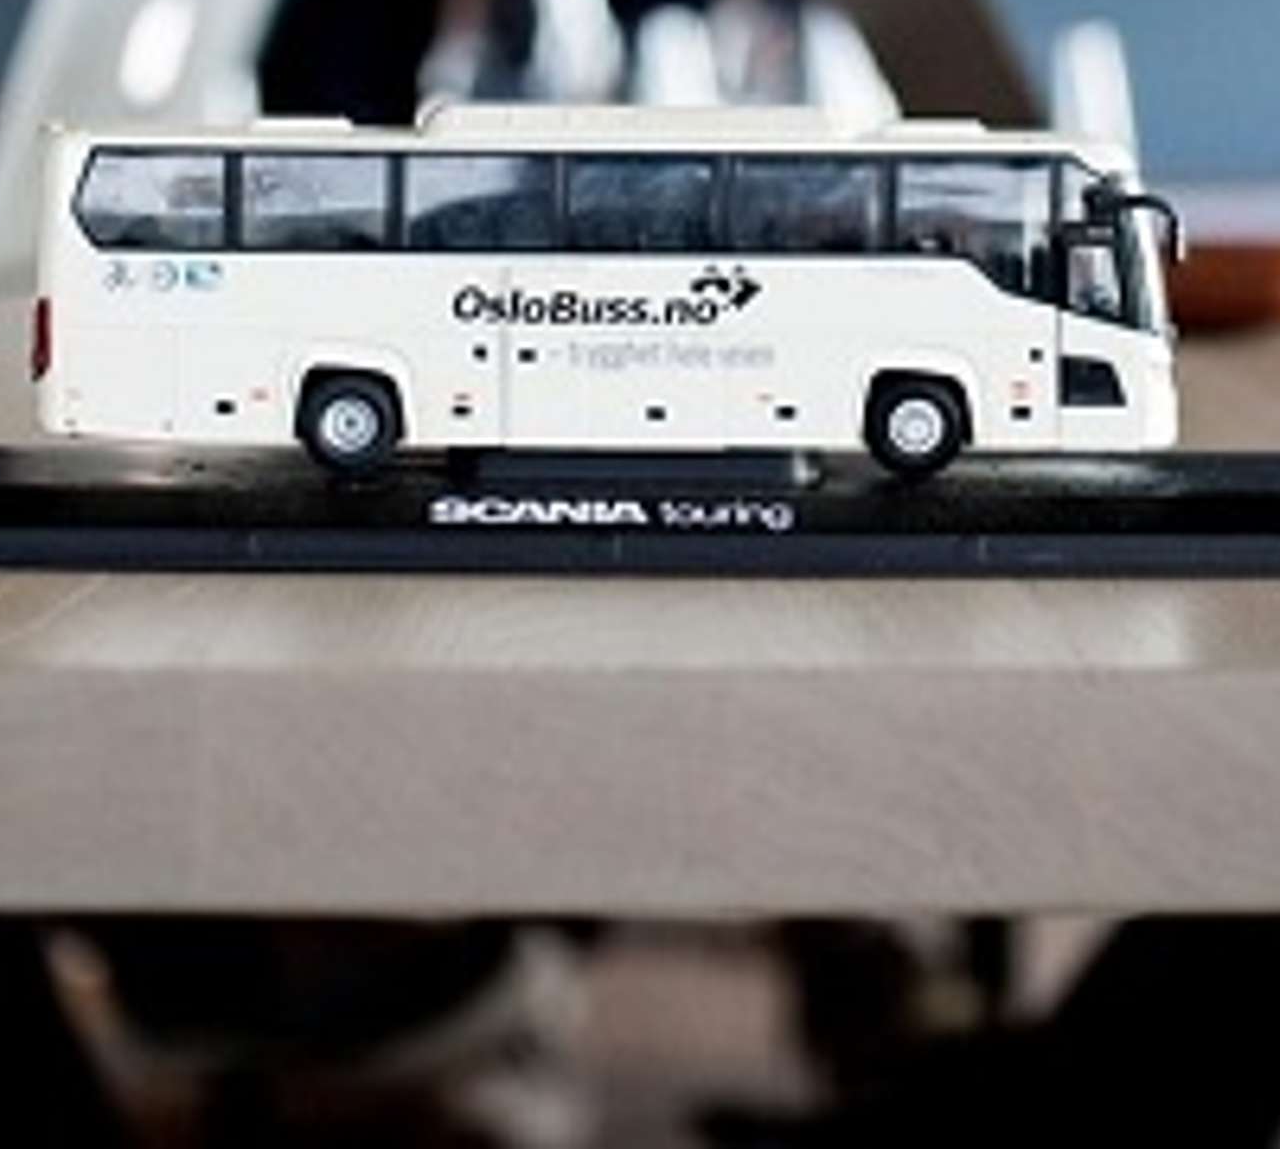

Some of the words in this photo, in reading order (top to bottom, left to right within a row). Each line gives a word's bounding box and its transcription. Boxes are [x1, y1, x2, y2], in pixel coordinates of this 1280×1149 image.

[452, 285, 720, 325] OsloBuss.no
[429, 497, 648, 525] SCANIA
[658, 499, 794, 531] touring
